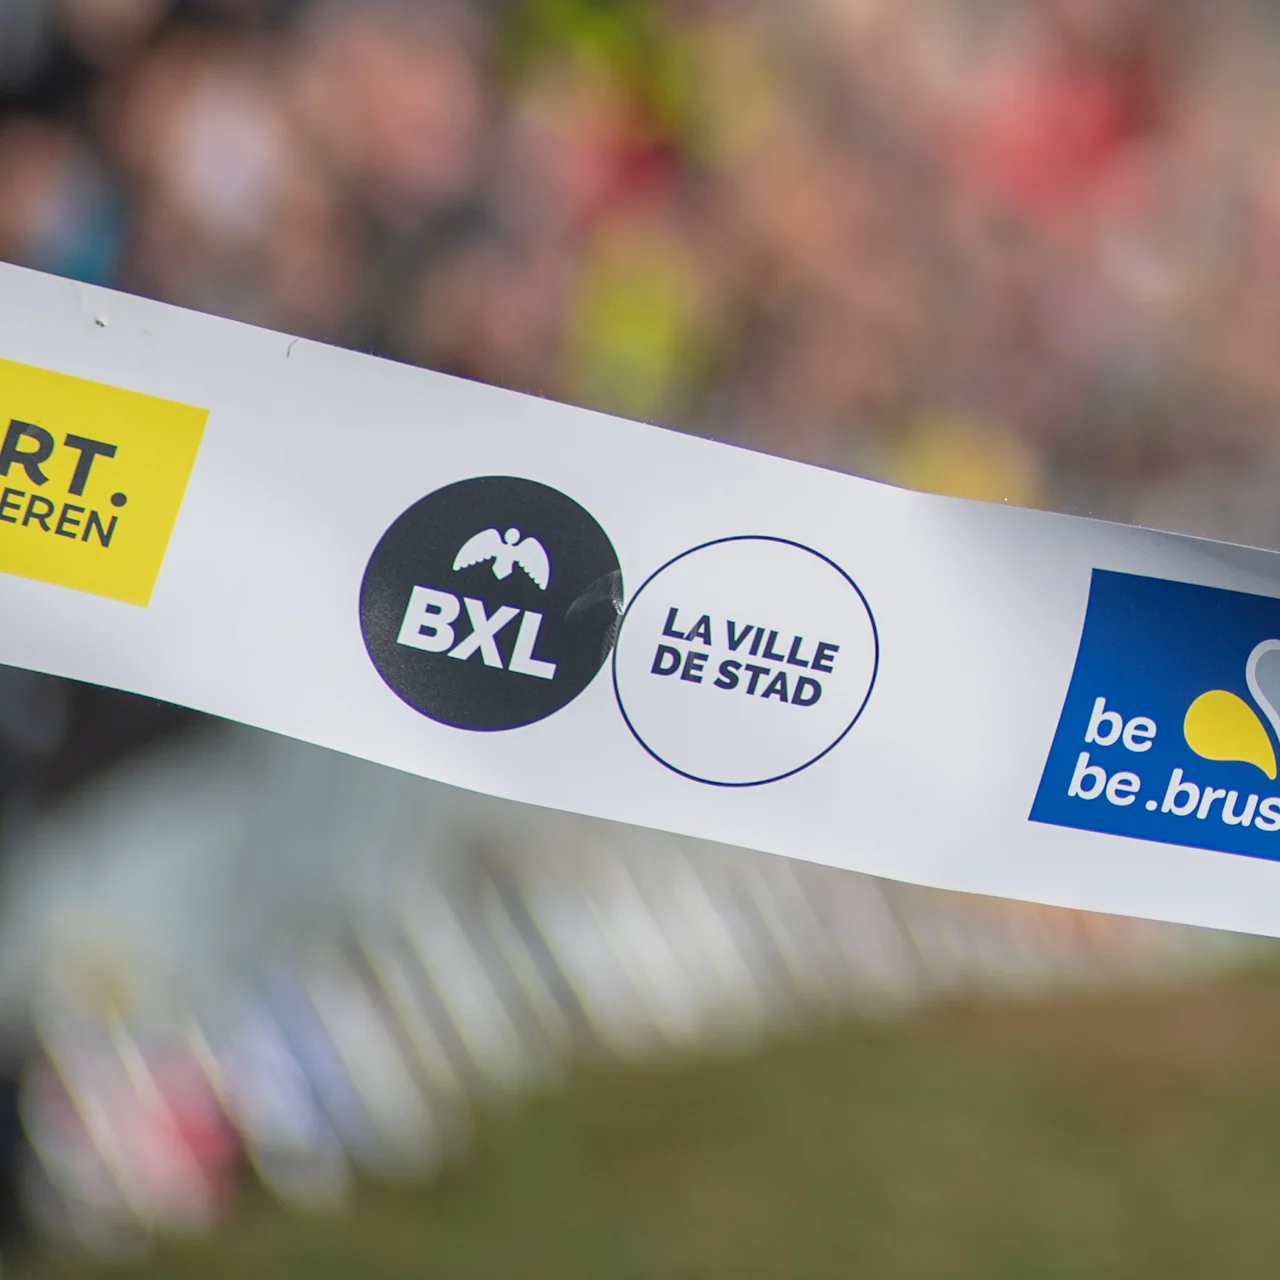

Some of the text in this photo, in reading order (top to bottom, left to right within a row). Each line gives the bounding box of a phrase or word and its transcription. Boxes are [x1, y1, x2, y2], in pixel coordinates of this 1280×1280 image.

[0, 418, 128, 508] RT.
[0, 486, 119, 549] EREN
[396, 585, 558, 680] BXL
[661, 606, 841, 674] LA VILLE
[650, 643, 823, 708] DE STAD
[1084, 697, 1157, 753] be
